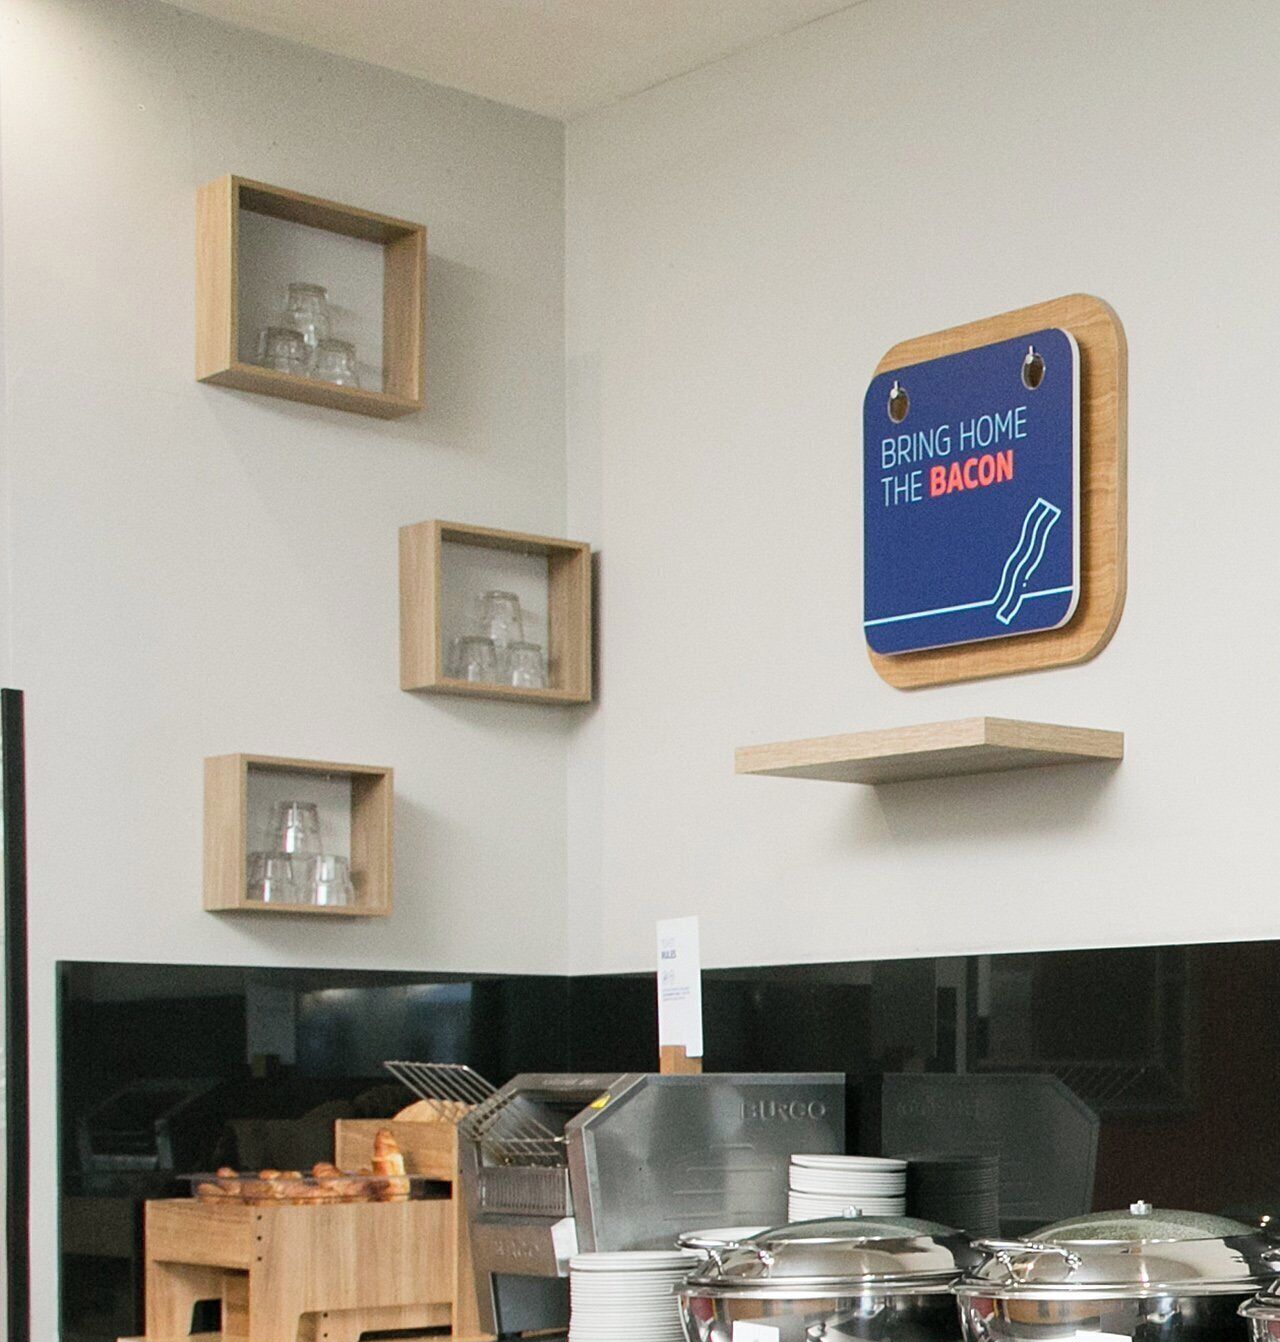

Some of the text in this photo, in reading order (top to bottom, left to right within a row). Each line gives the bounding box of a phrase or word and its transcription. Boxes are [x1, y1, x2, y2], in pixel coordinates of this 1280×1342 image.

[881, 406, 1027, 469] BRING HOME
[881, 450, 1014, 506] THE BACON
